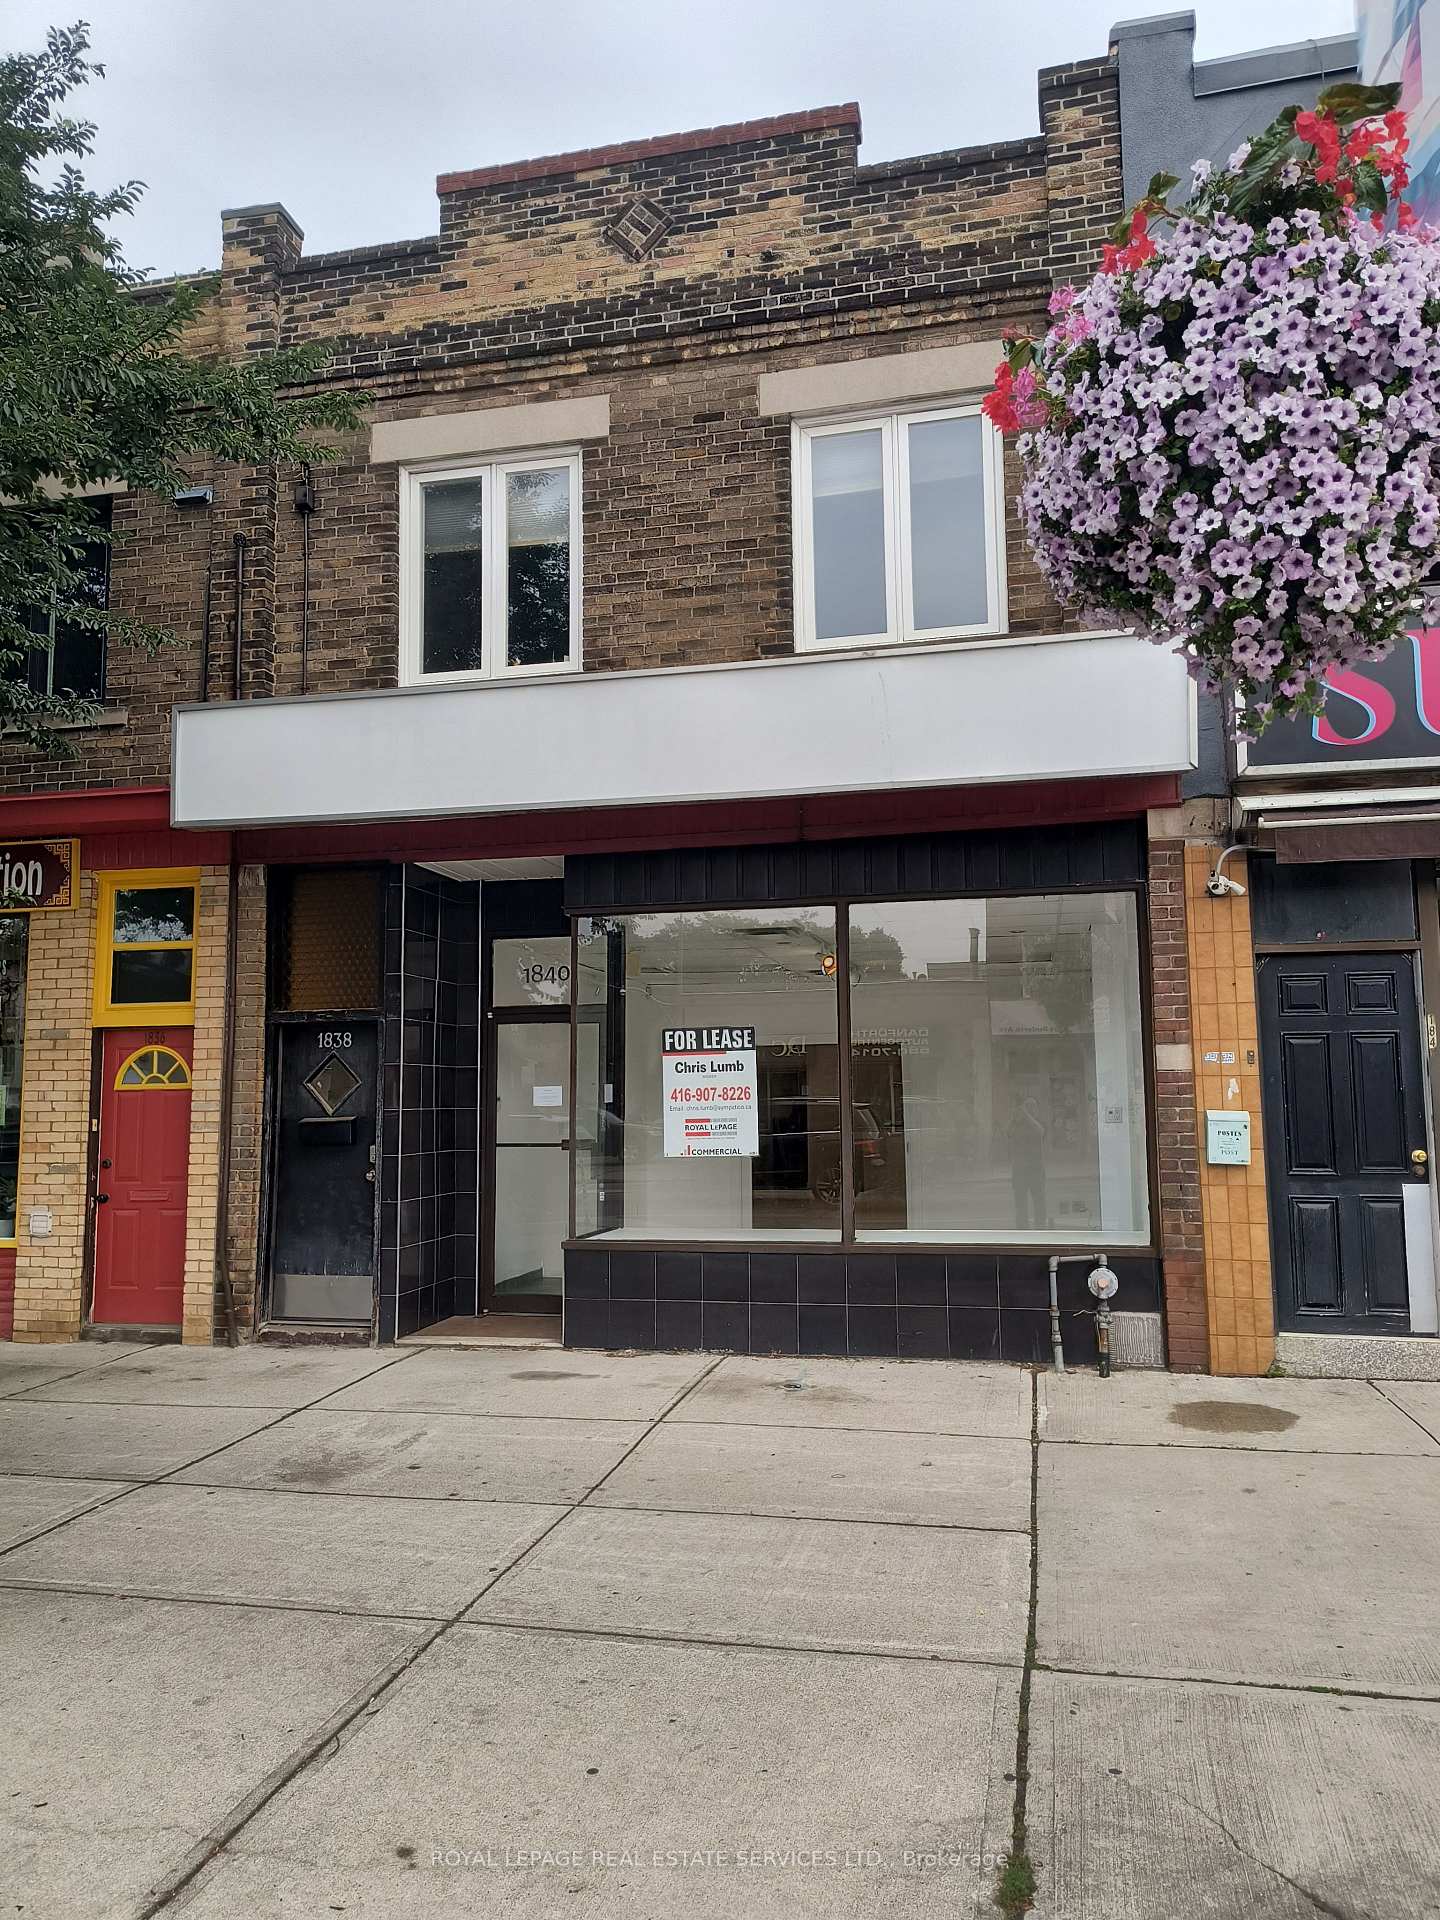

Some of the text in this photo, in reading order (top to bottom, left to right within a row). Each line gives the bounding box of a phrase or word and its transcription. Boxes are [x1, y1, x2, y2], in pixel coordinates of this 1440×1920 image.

[523, 964, 570, 984] 1840
[317, 1032, 353, 1048] 1838
[664, 1028, 753, 1051] FOR LEASE
[674, 1060, 745, 1074] Chris Lumb
[671, 1086, 752, 1102] 416-907-8226
[684, 1124, 709, 1132] ROYAL
[691, 1147, 742, 1156] COMMERCIAL
